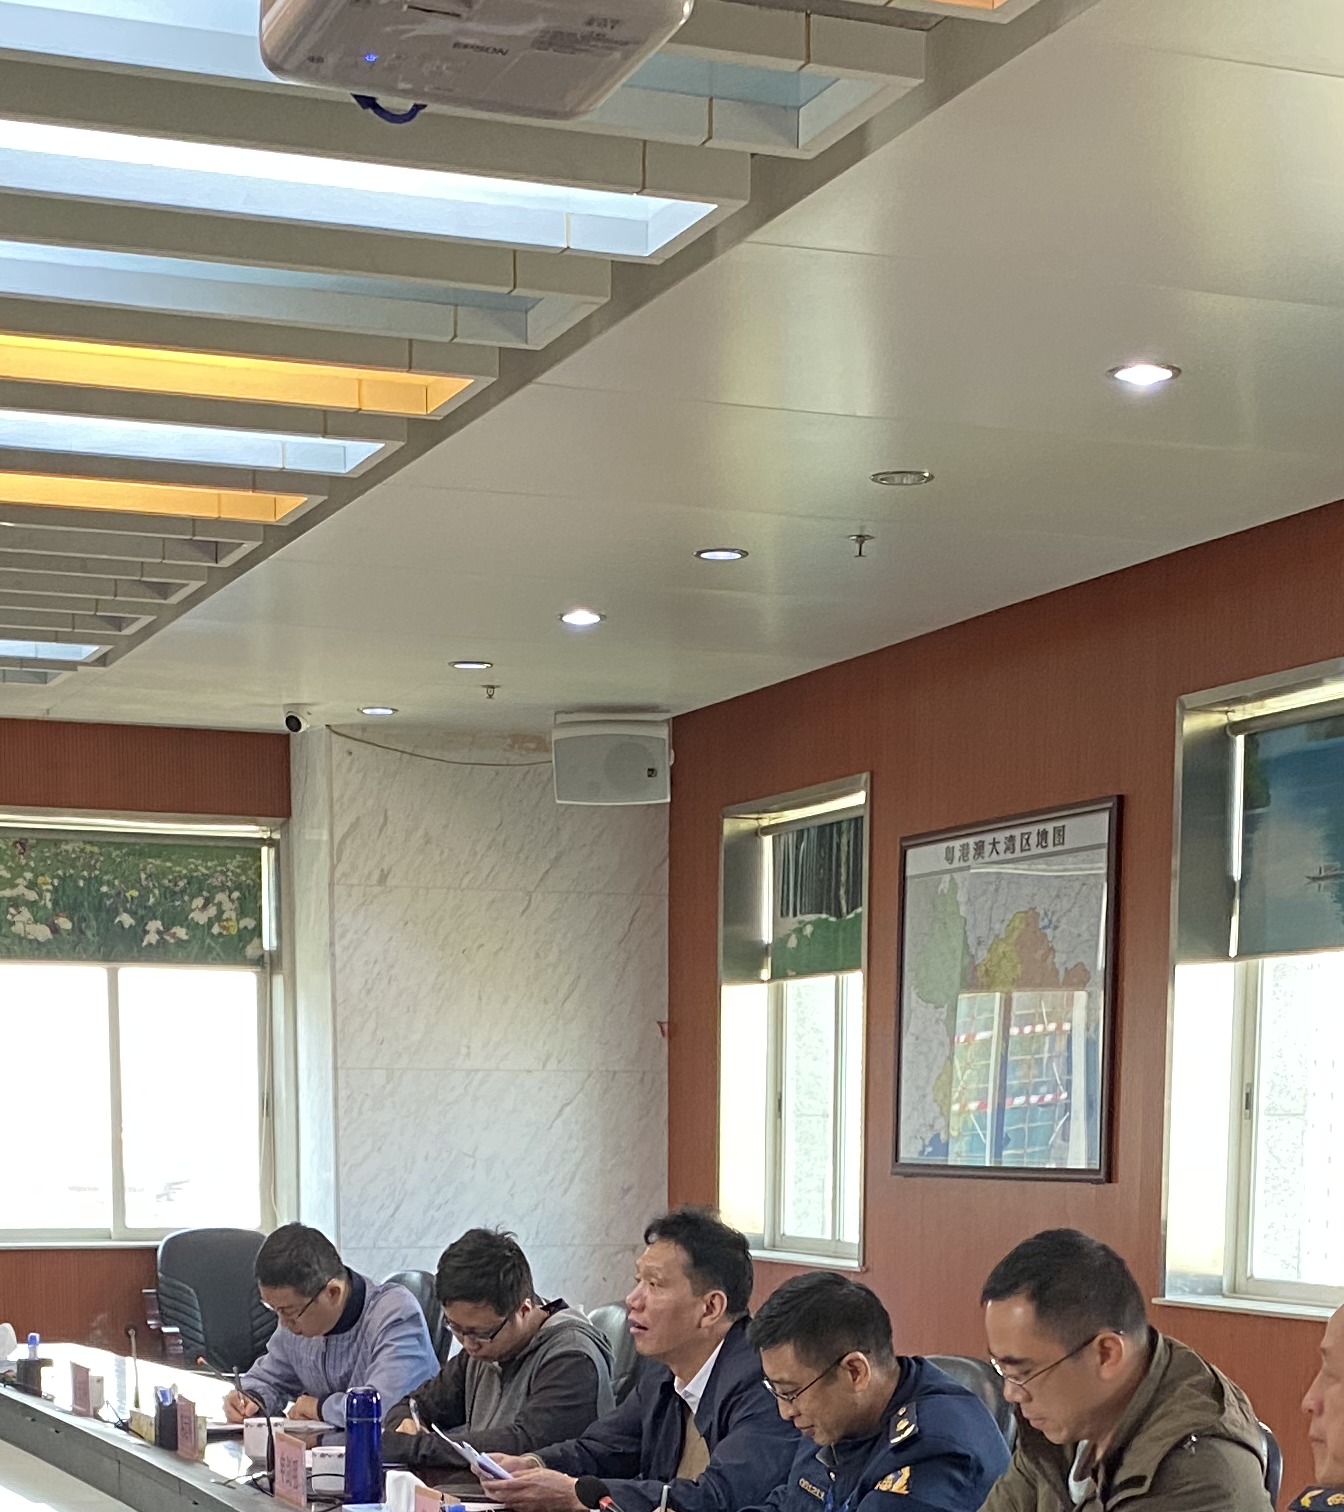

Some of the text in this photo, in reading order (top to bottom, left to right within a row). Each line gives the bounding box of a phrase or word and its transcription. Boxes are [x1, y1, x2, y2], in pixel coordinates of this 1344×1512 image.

[944, 825, 1066, 865] 粤港澳大湾区地图
